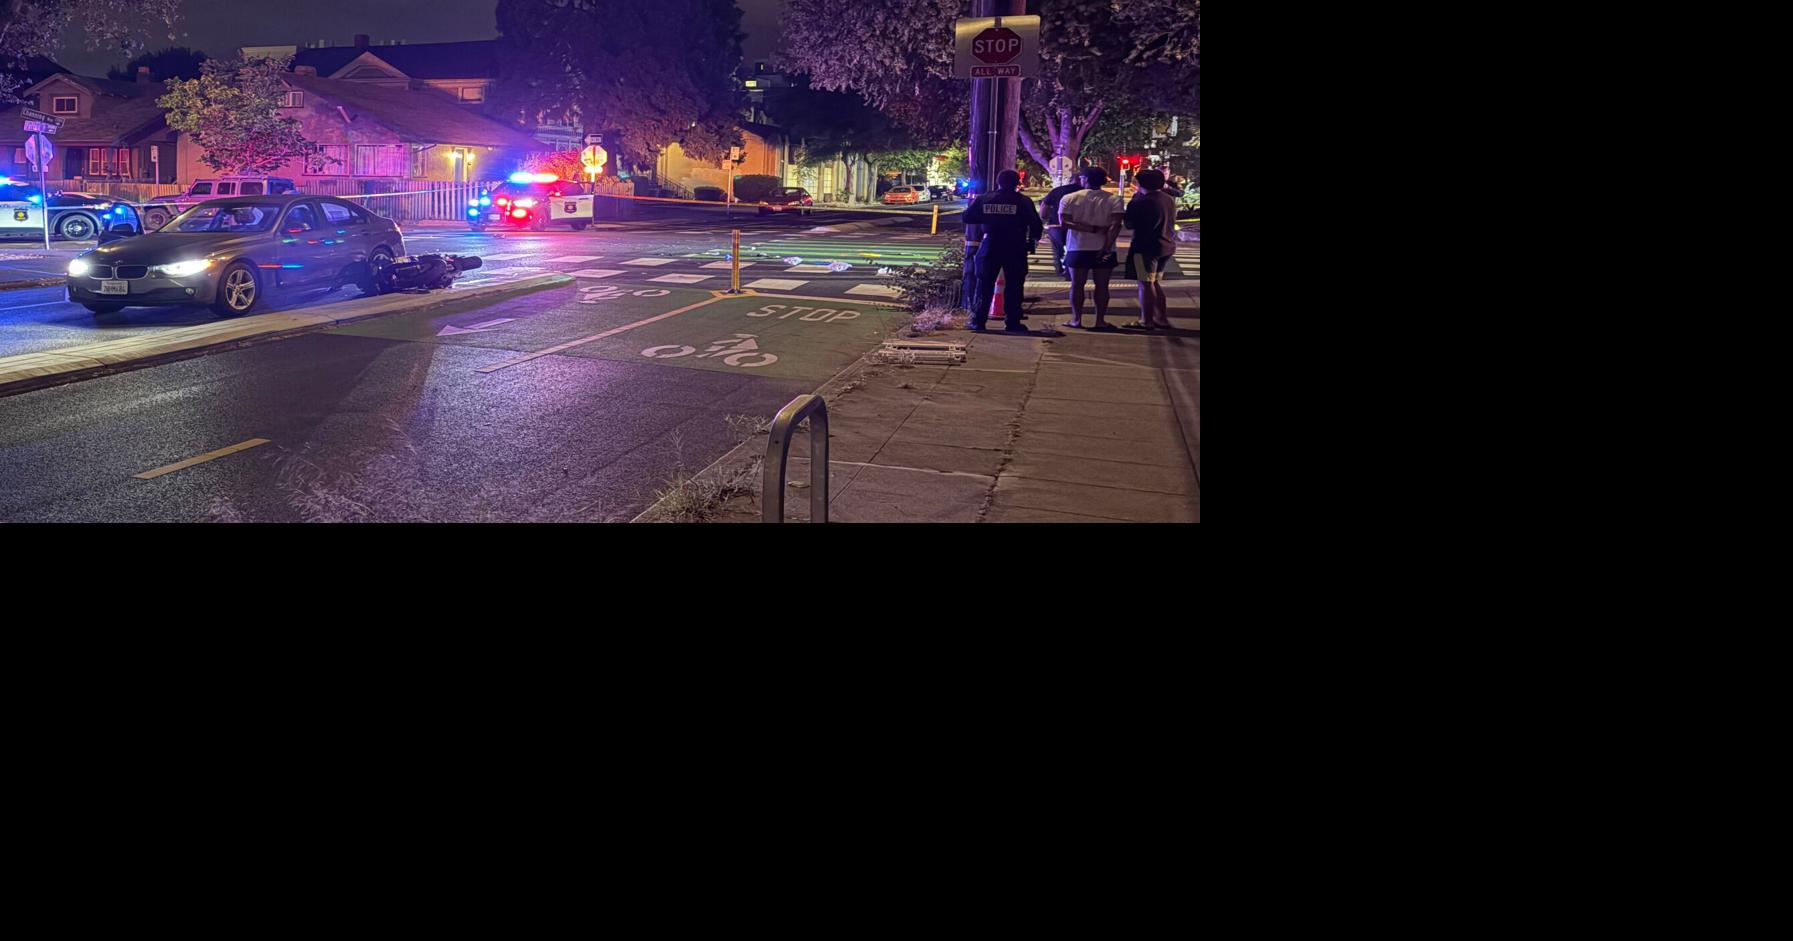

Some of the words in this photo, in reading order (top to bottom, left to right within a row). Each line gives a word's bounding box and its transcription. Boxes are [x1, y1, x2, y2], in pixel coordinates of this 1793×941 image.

[974, 38, 1019, 53] STOP
[974, 68, 991, 76] ALL
[997, 67, 1015, 75] WAY
[985, 204, 1015, 214] POLICE
[746, 304, 861, 323] STOP
